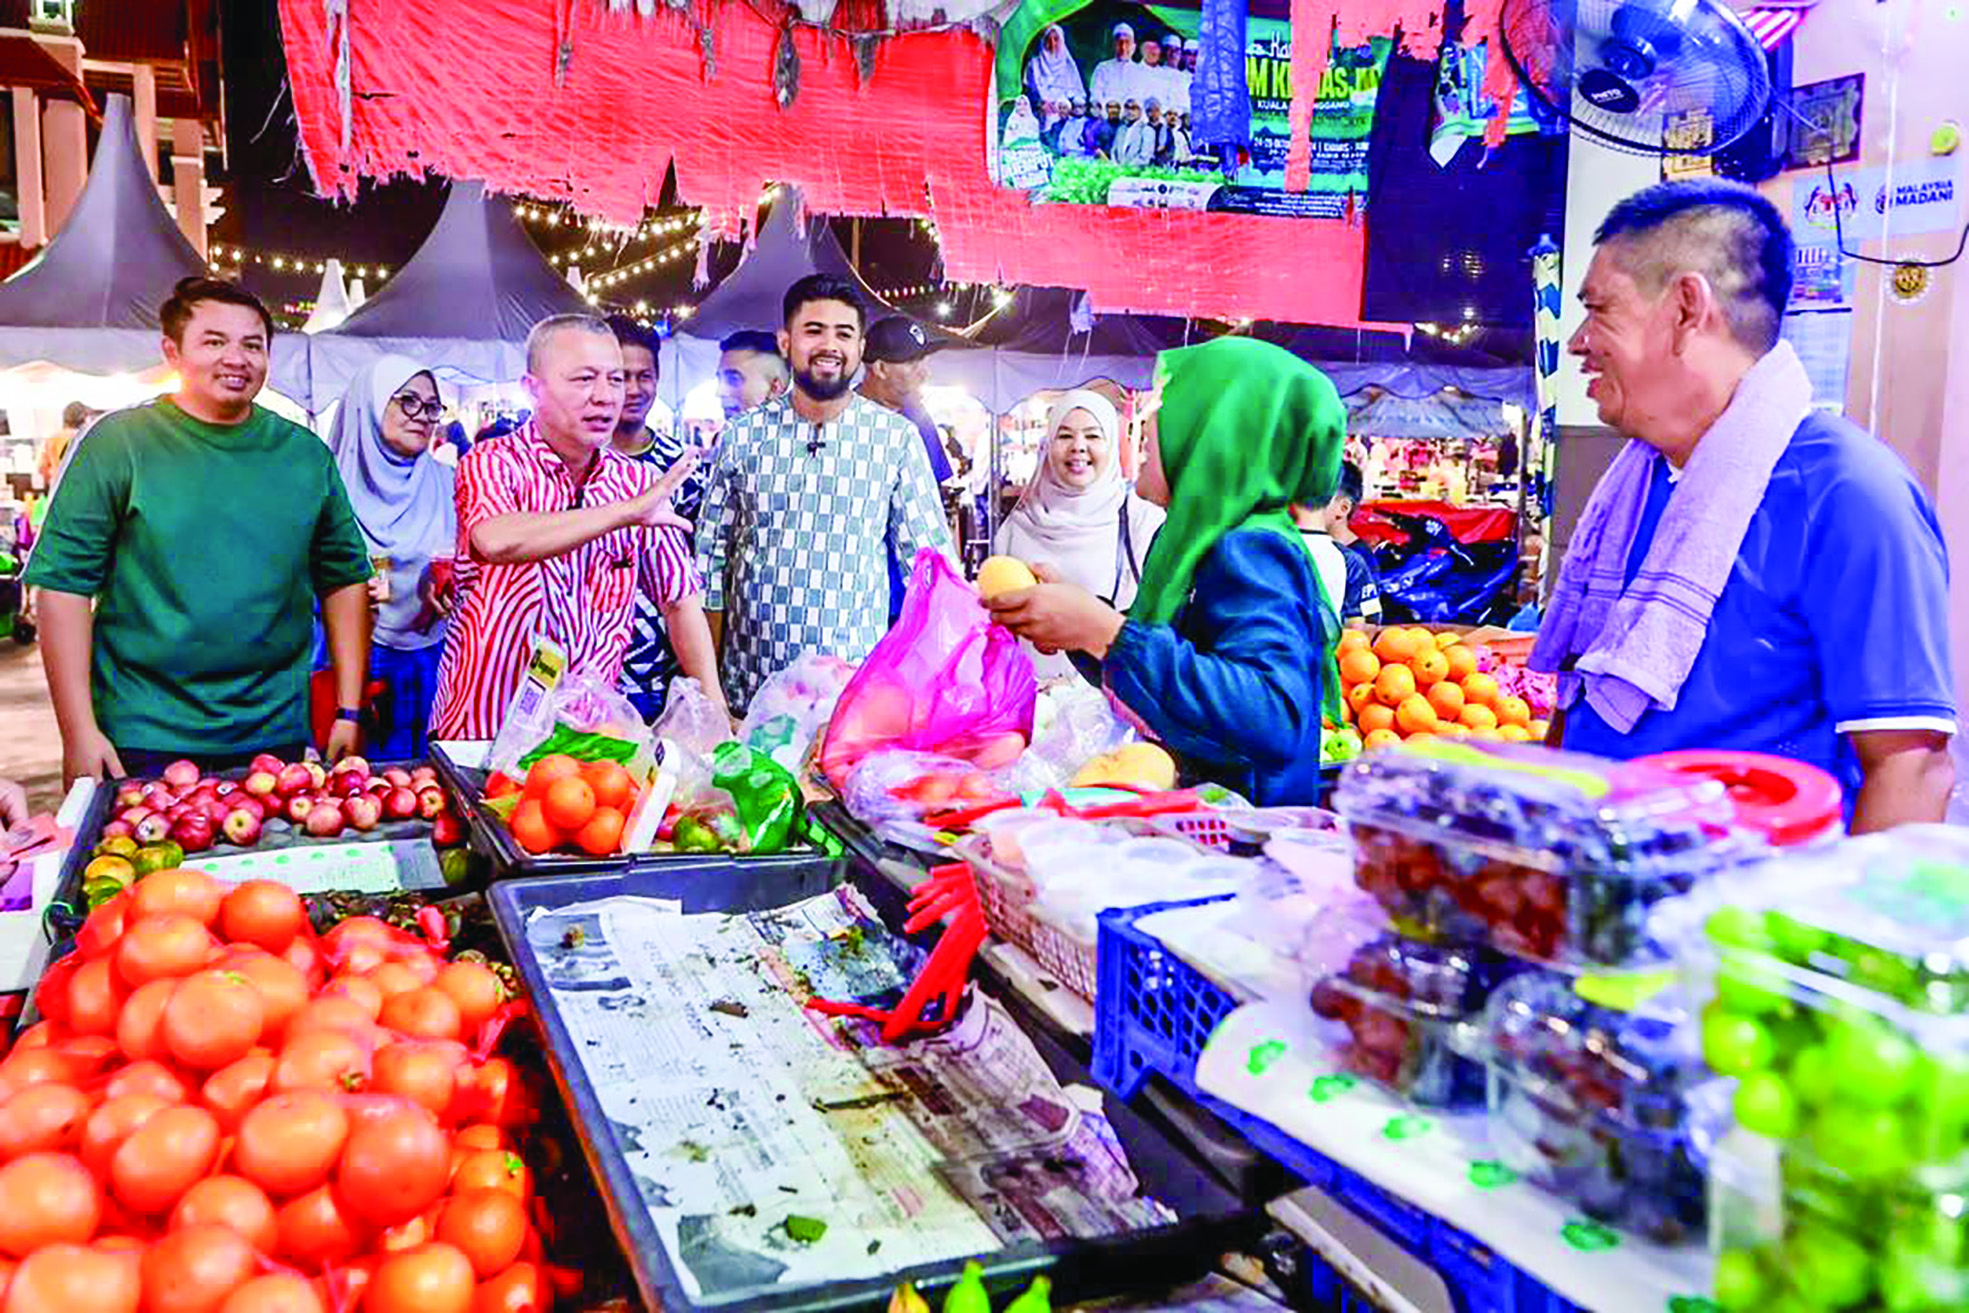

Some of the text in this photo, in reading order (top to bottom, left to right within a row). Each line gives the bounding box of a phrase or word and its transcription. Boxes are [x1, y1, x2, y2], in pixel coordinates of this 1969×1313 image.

[1257, 100, 1288, 110] KUALA
[1896, 179, 1953, 195] MALAYSIA
[1895, 189, 1954, 207] MADANI
